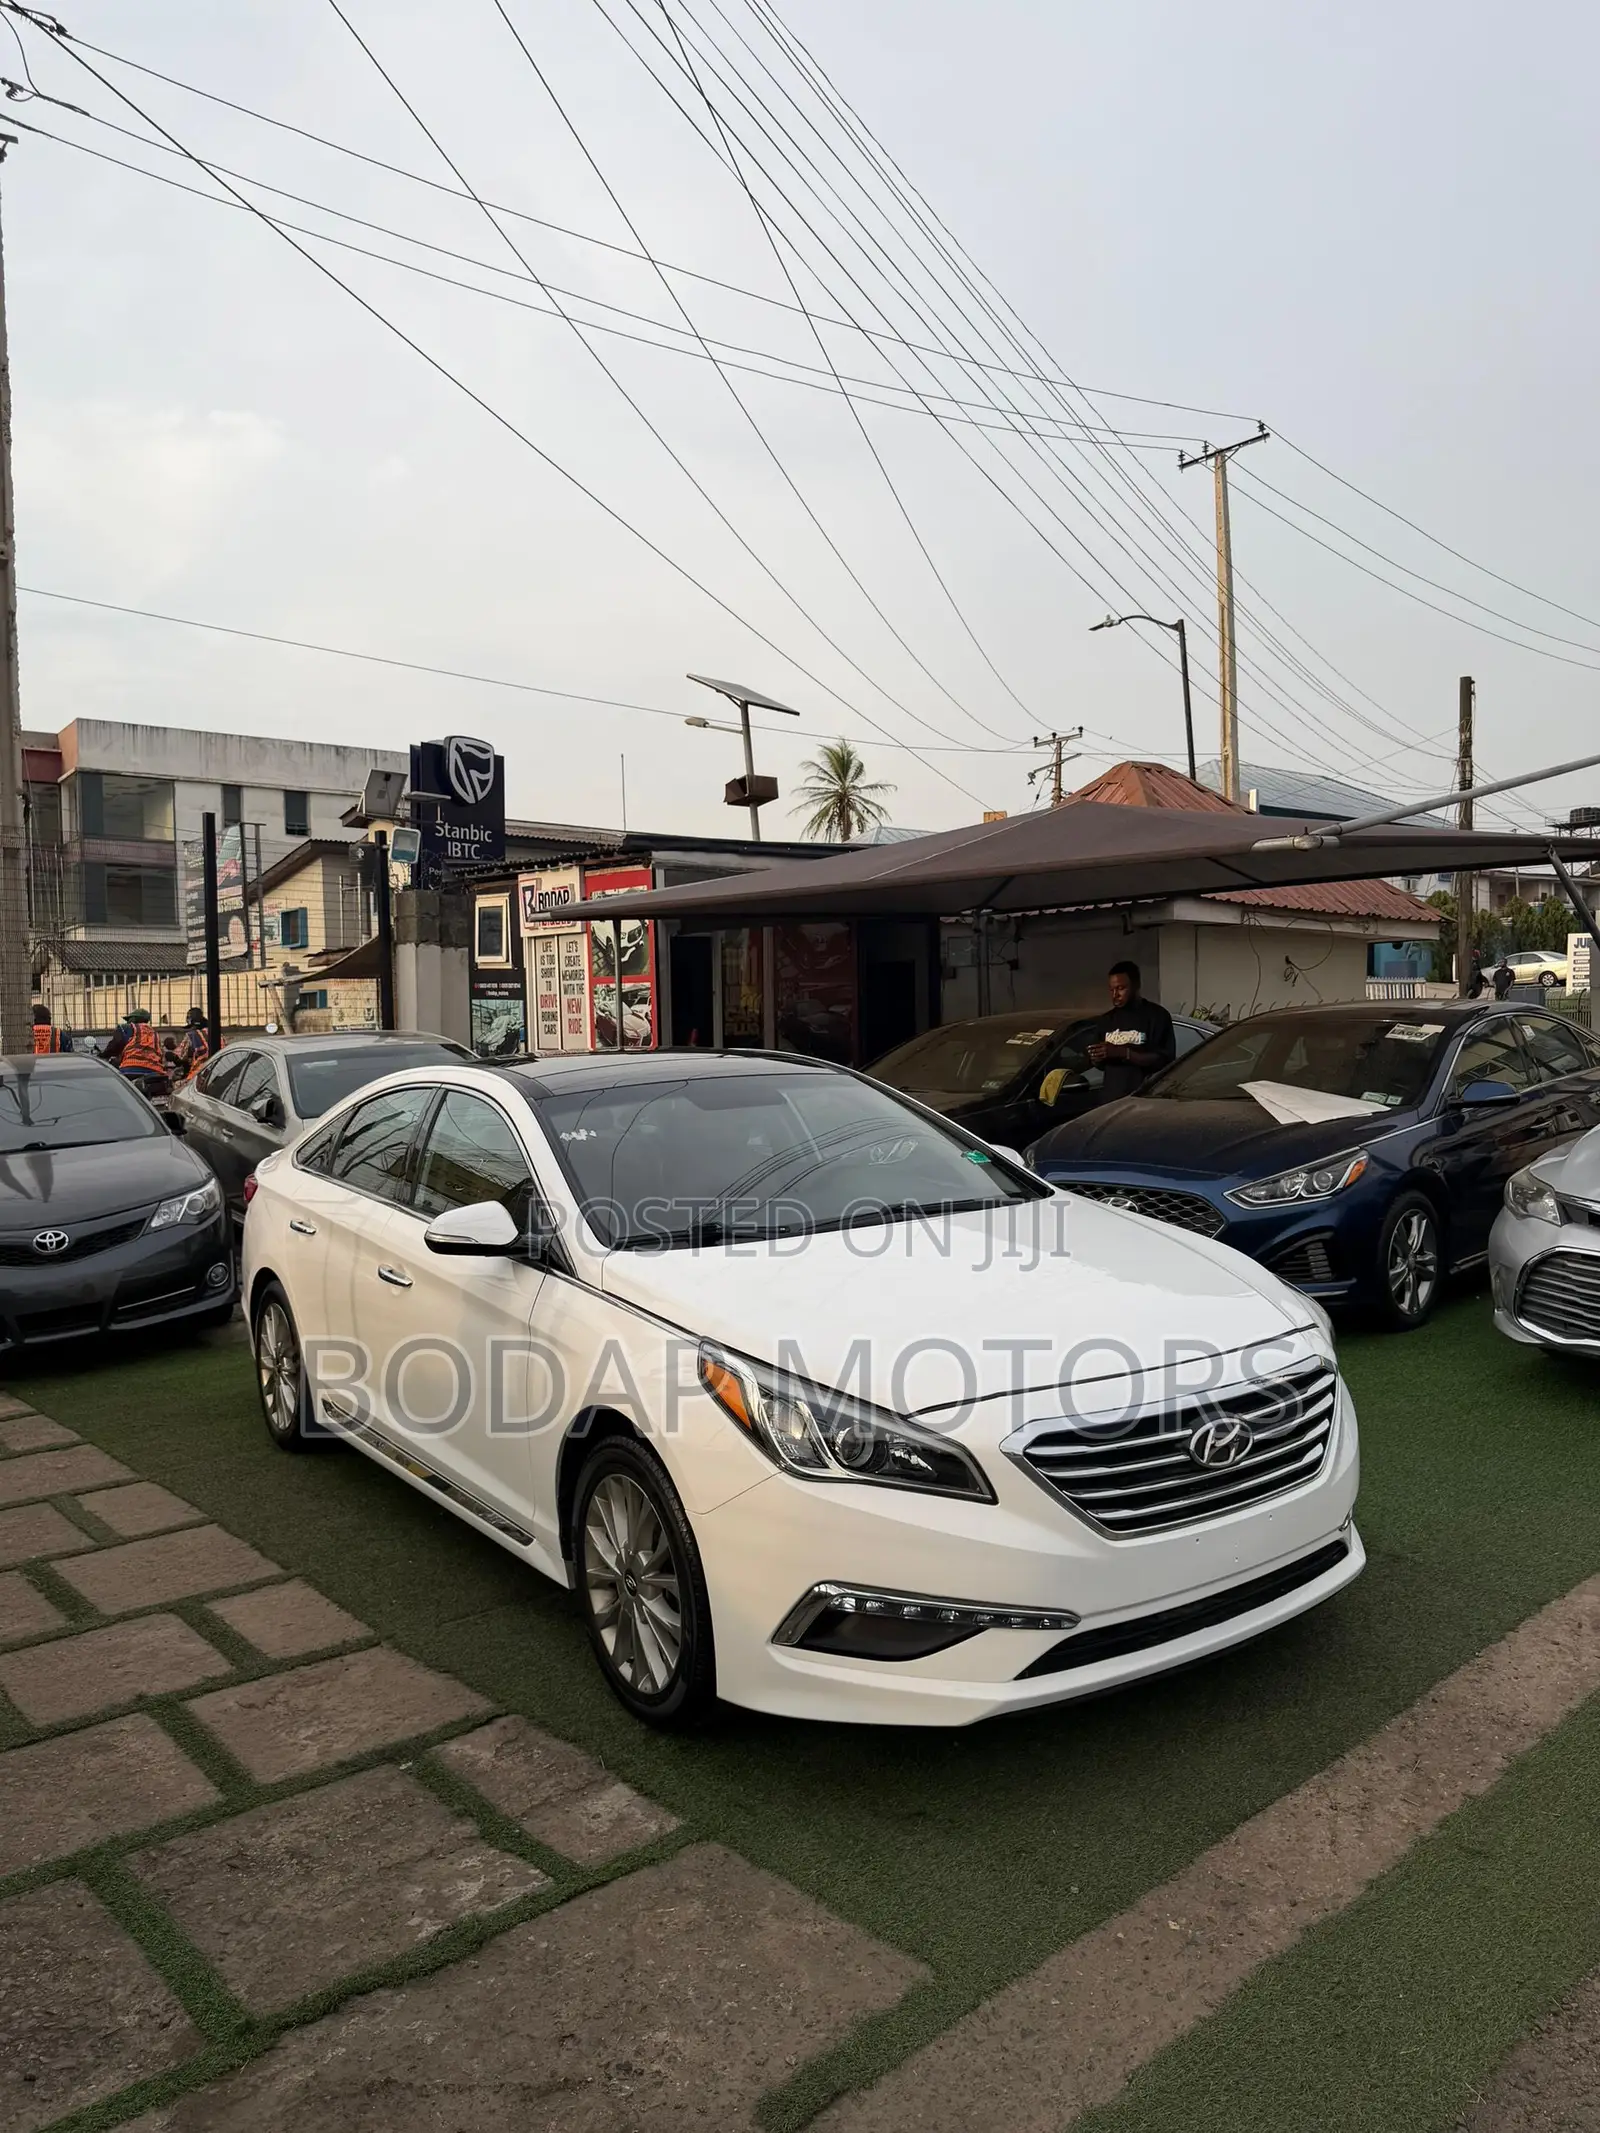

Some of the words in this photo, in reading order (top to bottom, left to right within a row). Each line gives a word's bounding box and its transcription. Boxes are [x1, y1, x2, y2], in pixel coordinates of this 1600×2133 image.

[435, 820, 492, 842] Stanbic
[448, 841, 480, 859] IBTC
[542, 941, 553, 952] LIFE
[566, 940, 579, 953] LET'S
[540, 954, 546, 966] IS
[546, 954, 555, 965] TOO
[565, 955, 581, 967] CREATE
[541, 967, 556, 979] SHORT
[562, 969, 585, 981] MEMORIES
[545, 980, 552, 992] TO
[563, 983, 576, 995] WITH
[576, 983, 585, 995] THE
[540, 994, 558, 1009] DRIVE
[567, 998, 582, 1014] NEW
[541, 1011, 558, 1022] BORING
[544, 1023, 557, 1035] CARS
[568, 1018, 583, 1035] RIDE
